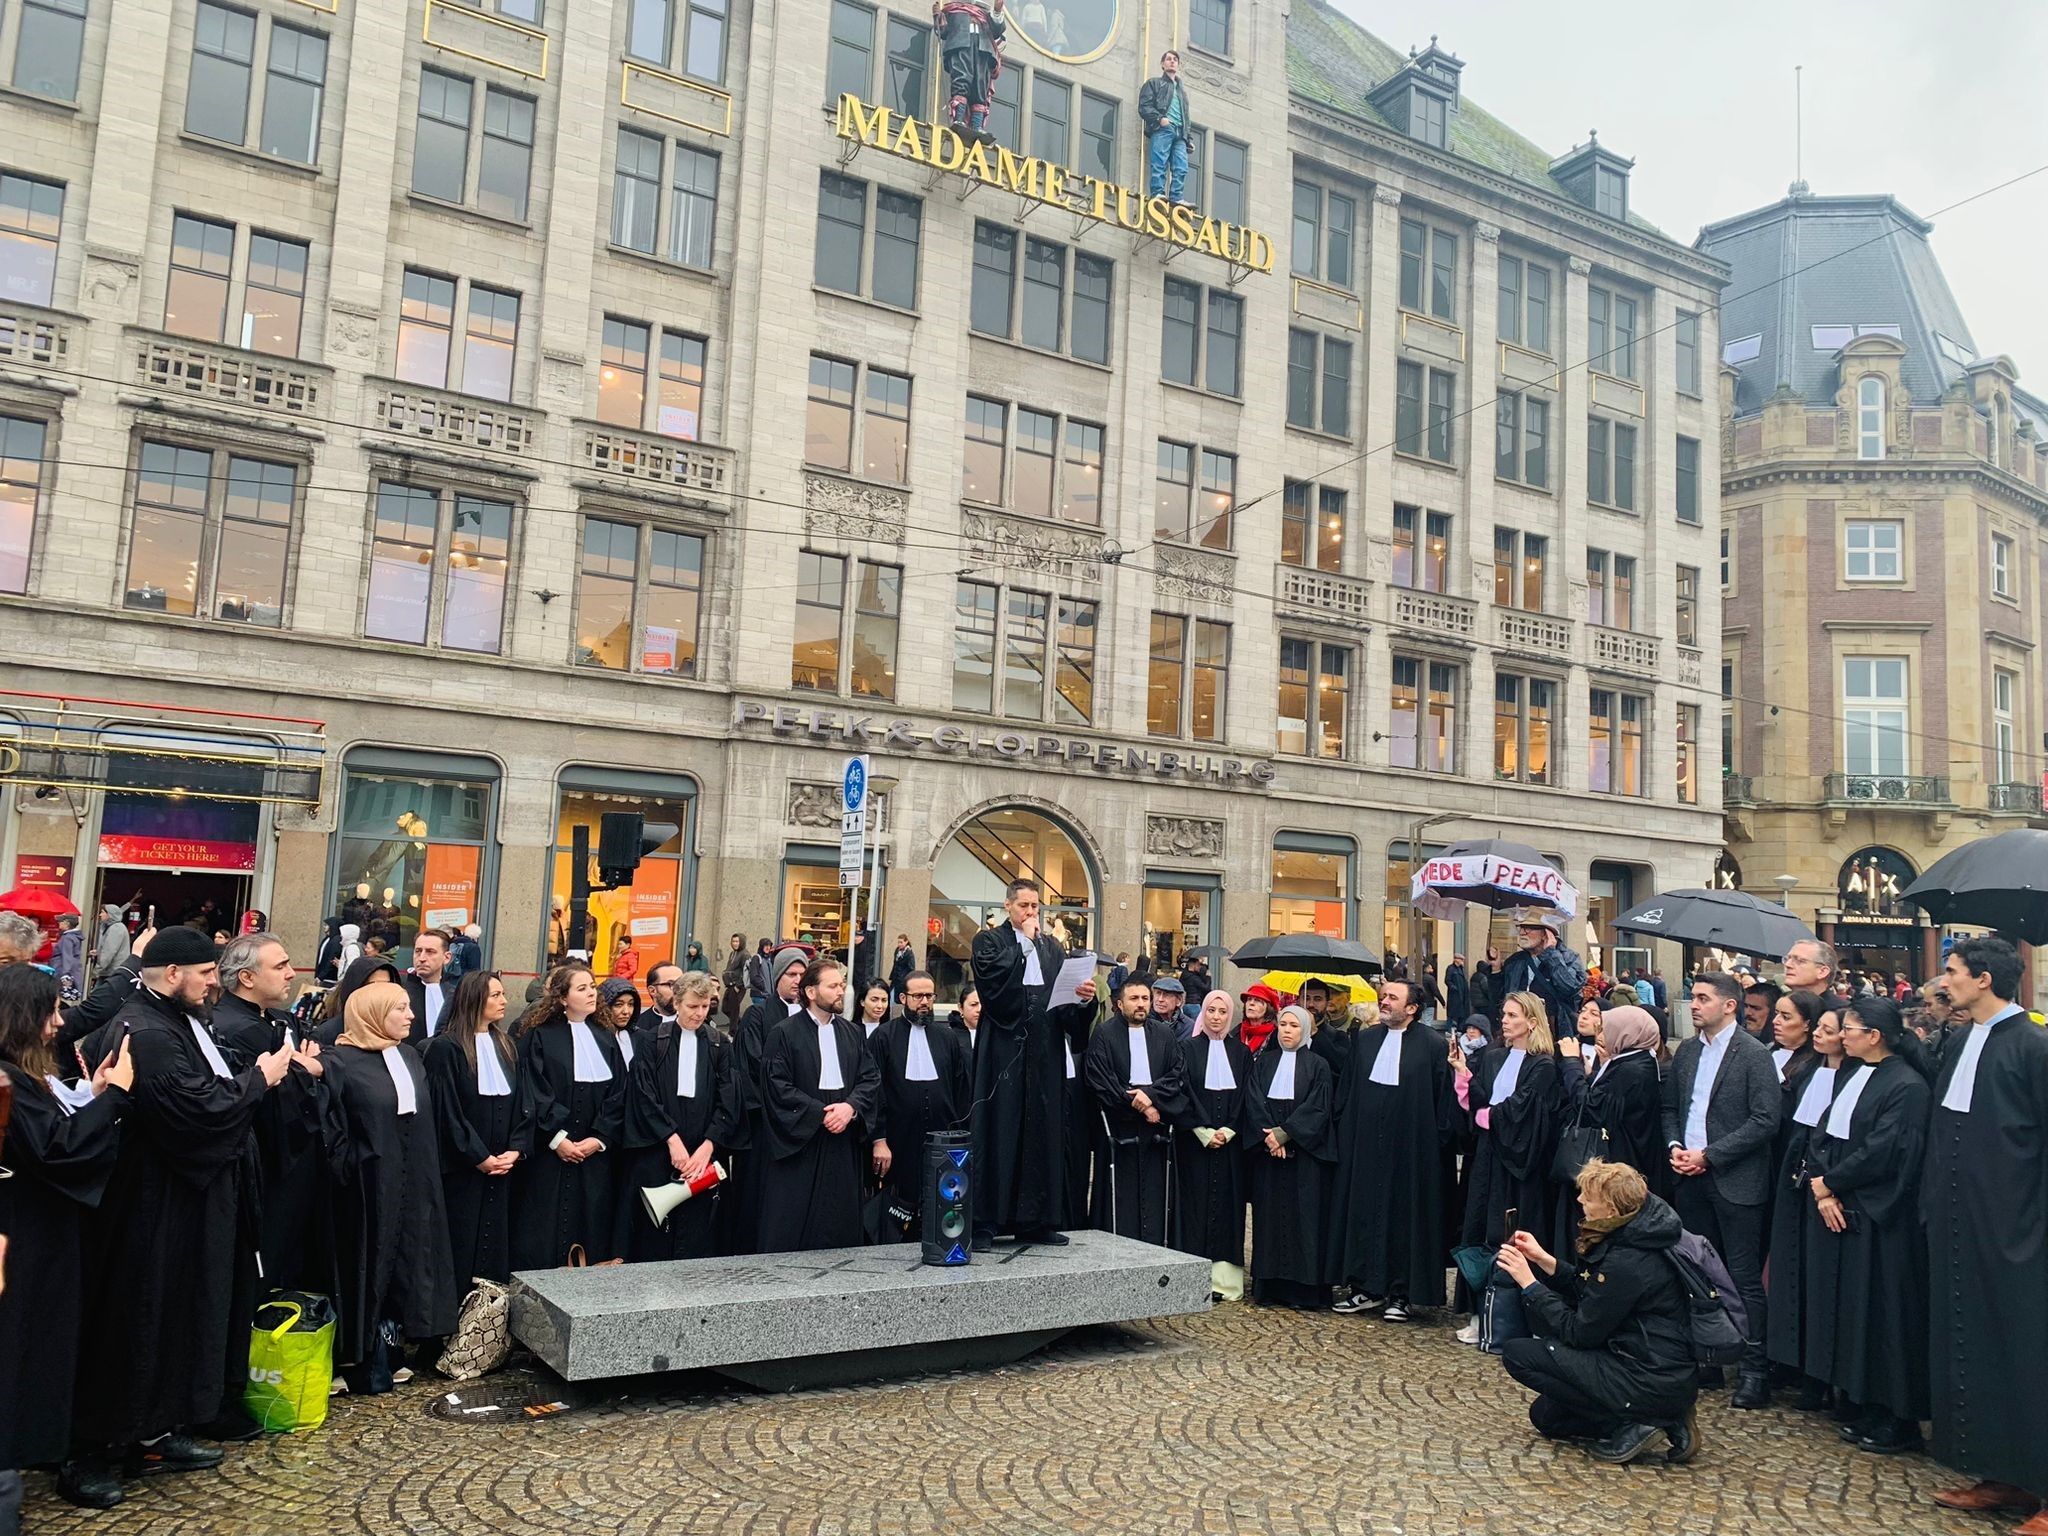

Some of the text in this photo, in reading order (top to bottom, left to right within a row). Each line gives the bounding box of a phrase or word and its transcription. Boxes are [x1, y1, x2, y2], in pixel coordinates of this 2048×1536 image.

[836, 93, 1277, 275] MADAME TUSSAUD
[152, 843, 207, 853] GET YOUR
[140, 850, 220, 862] TICKETS HERE!
[432, 883, 467, 891] INSIDER
[1494, 863, 1563, 902] PEACE
[1873, 917, 1913, 925] EXCHANGE
